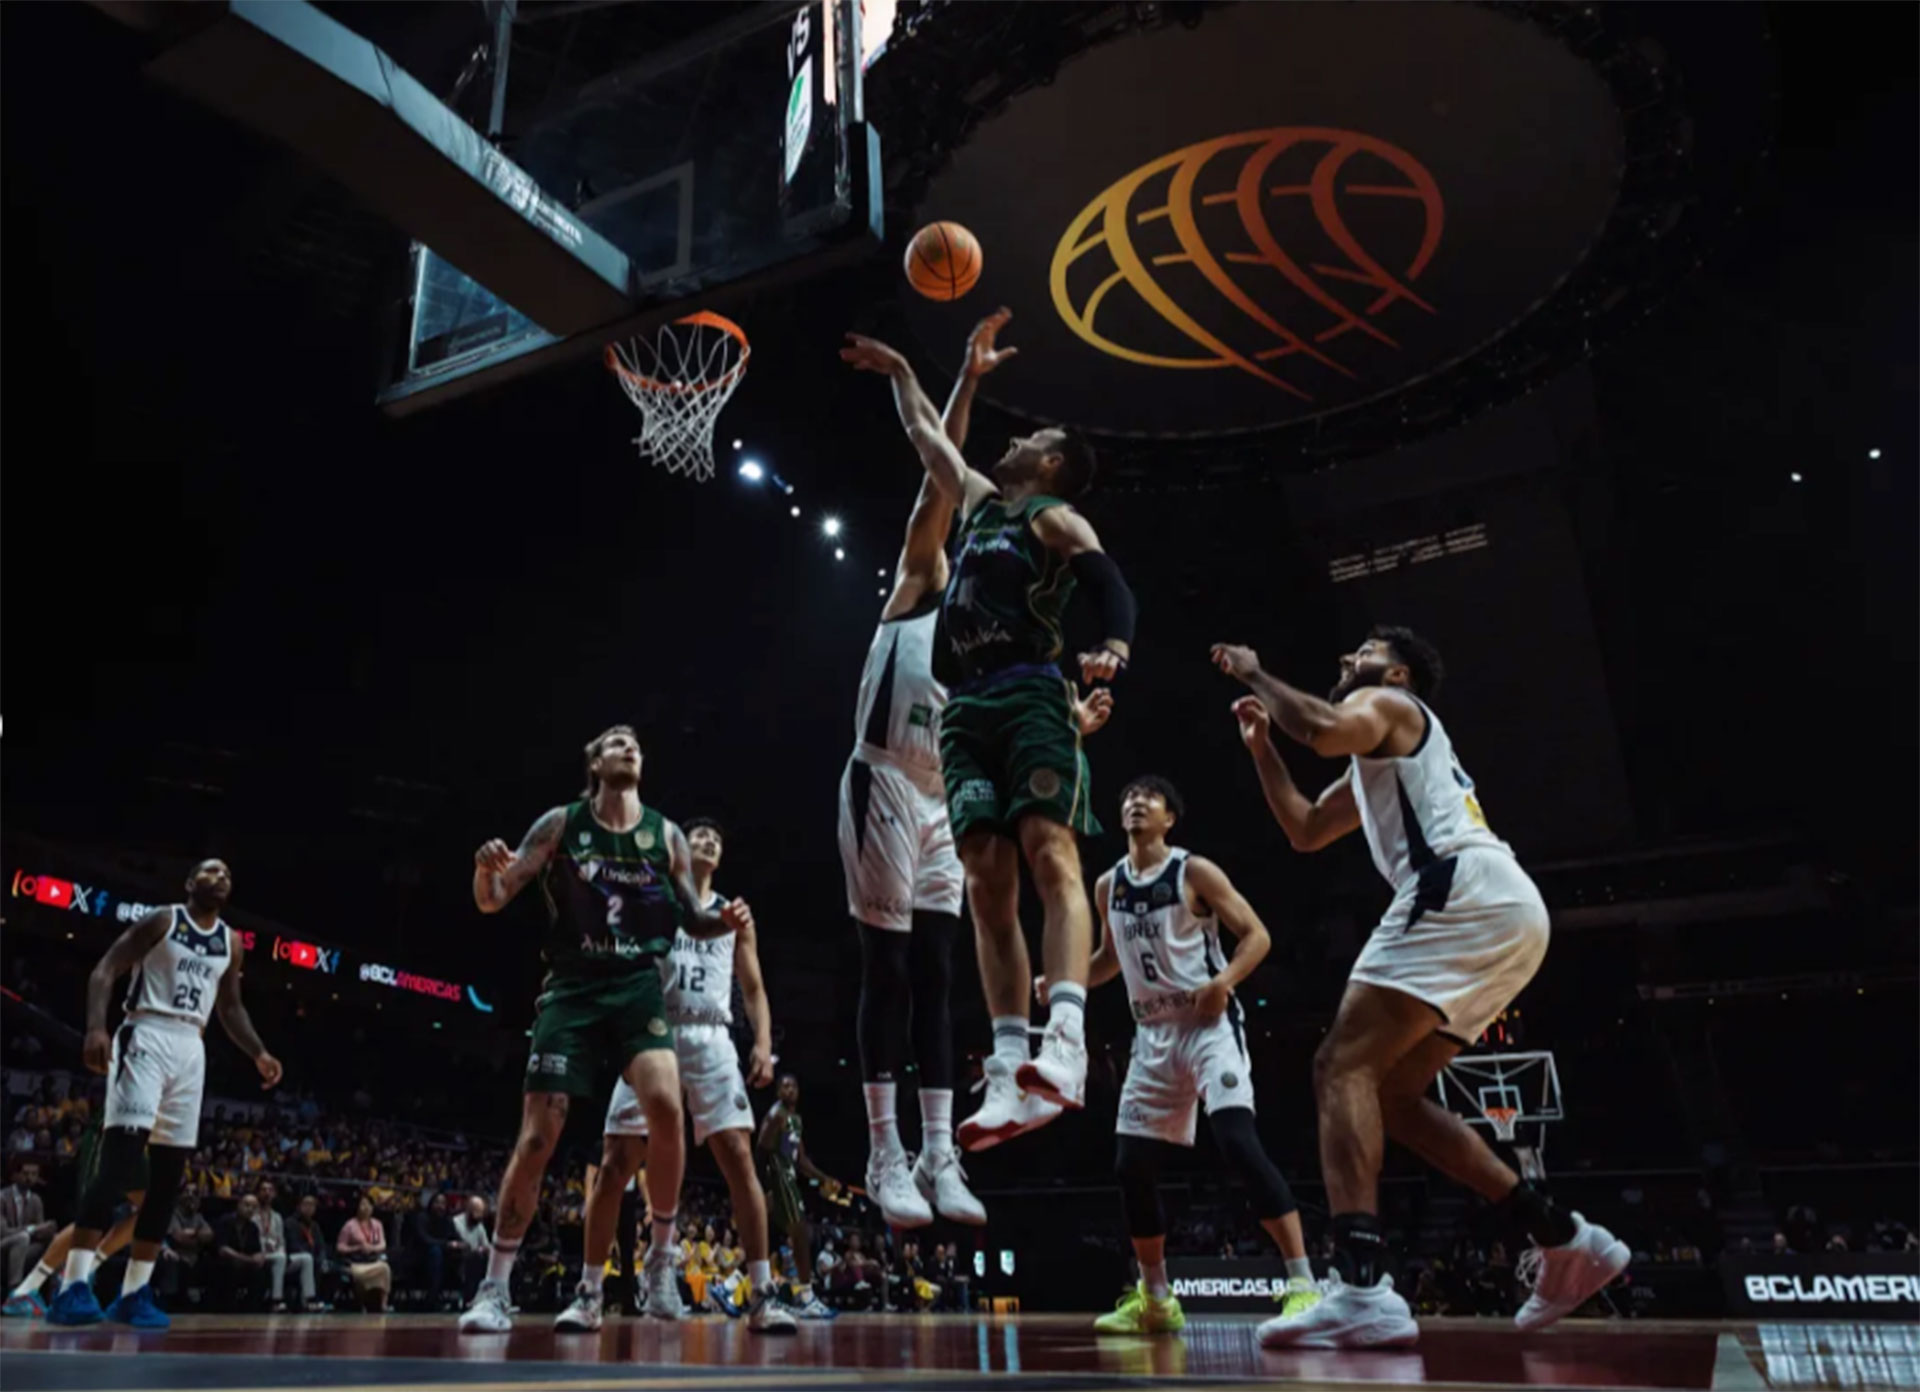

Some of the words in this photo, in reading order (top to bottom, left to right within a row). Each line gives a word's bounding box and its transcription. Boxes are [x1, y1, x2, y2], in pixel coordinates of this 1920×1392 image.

[606, 894, 624, 926] 2
[678, 964, 706, 992] 12
[1140, 952, 1158, 982] 6
[172, 984, 202, 1010] 25
